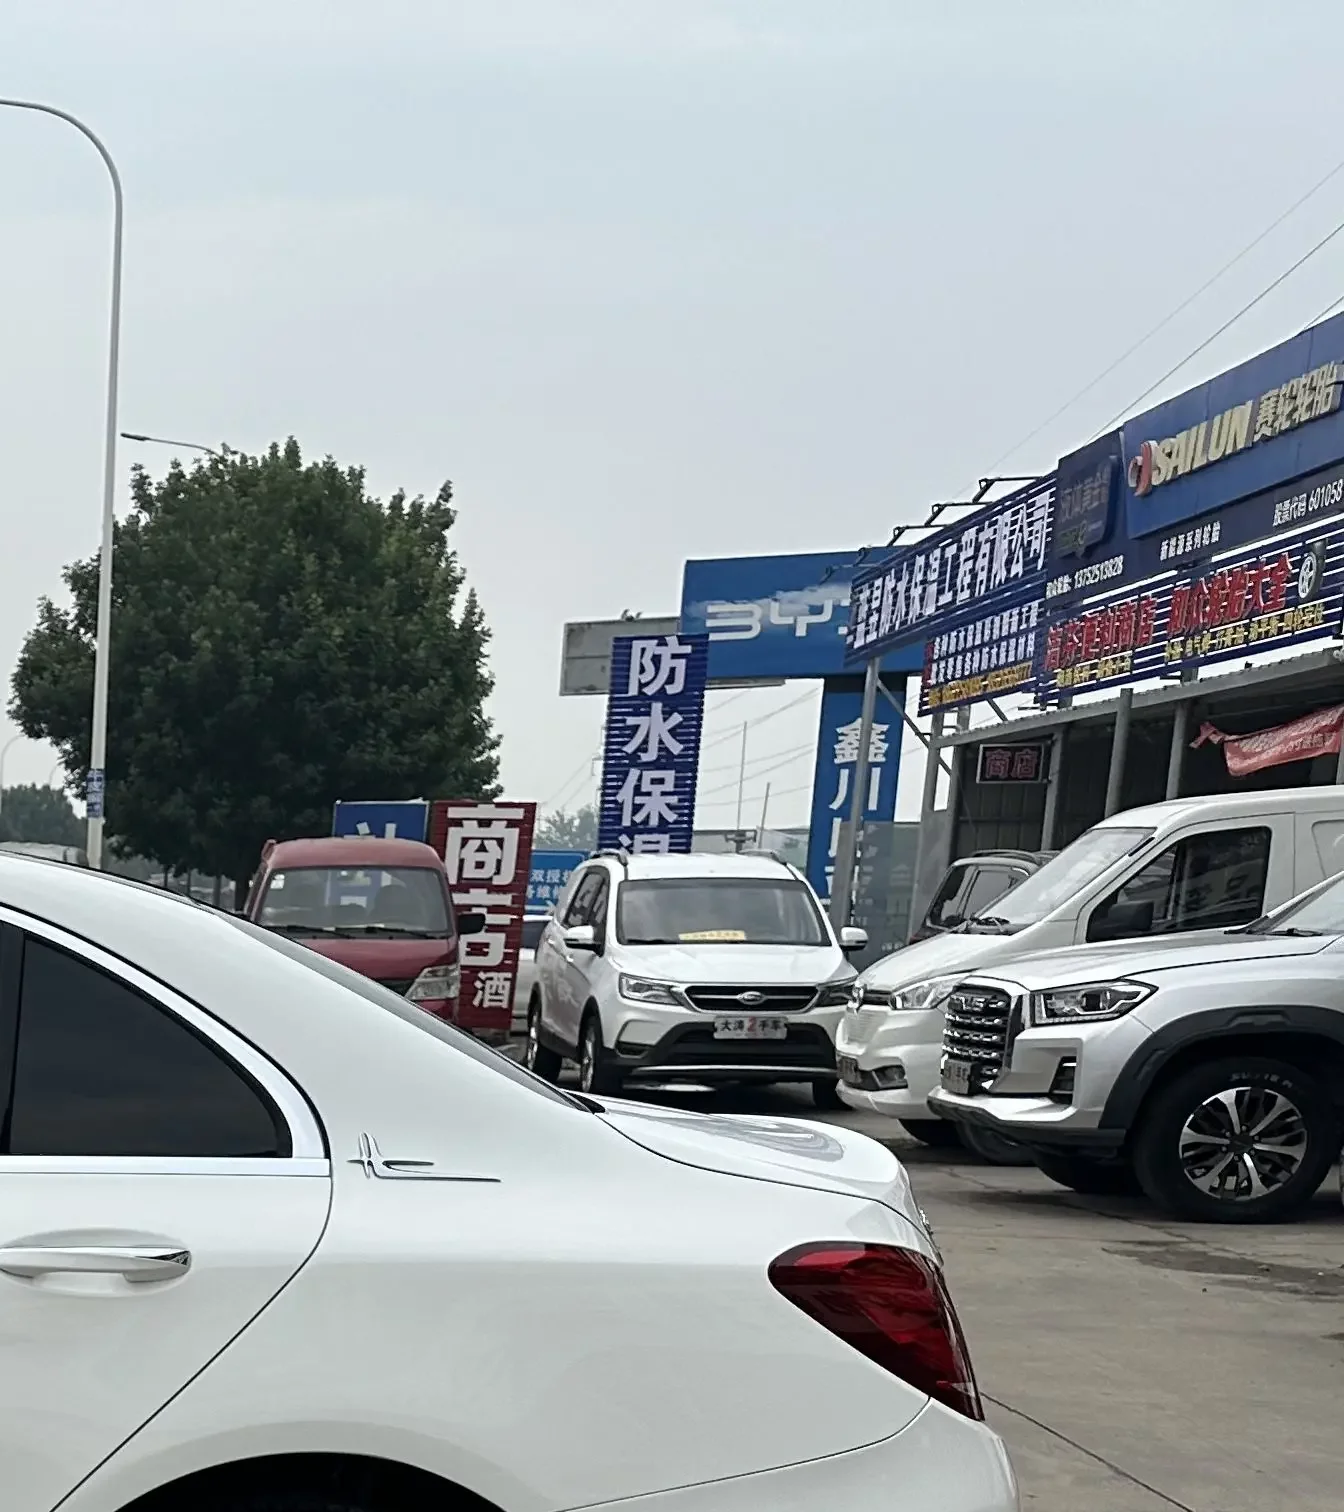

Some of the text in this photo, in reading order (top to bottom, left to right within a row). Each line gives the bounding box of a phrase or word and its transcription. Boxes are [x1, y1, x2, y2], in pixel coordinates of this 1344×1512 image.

[1151, 361, 1341, 486] SAILUN 赛轮轮胎
[1308, 478, 1344, 512] 601058
[705, 588, 852, 642] BY
[985, 749, 1039, 779] 商店
